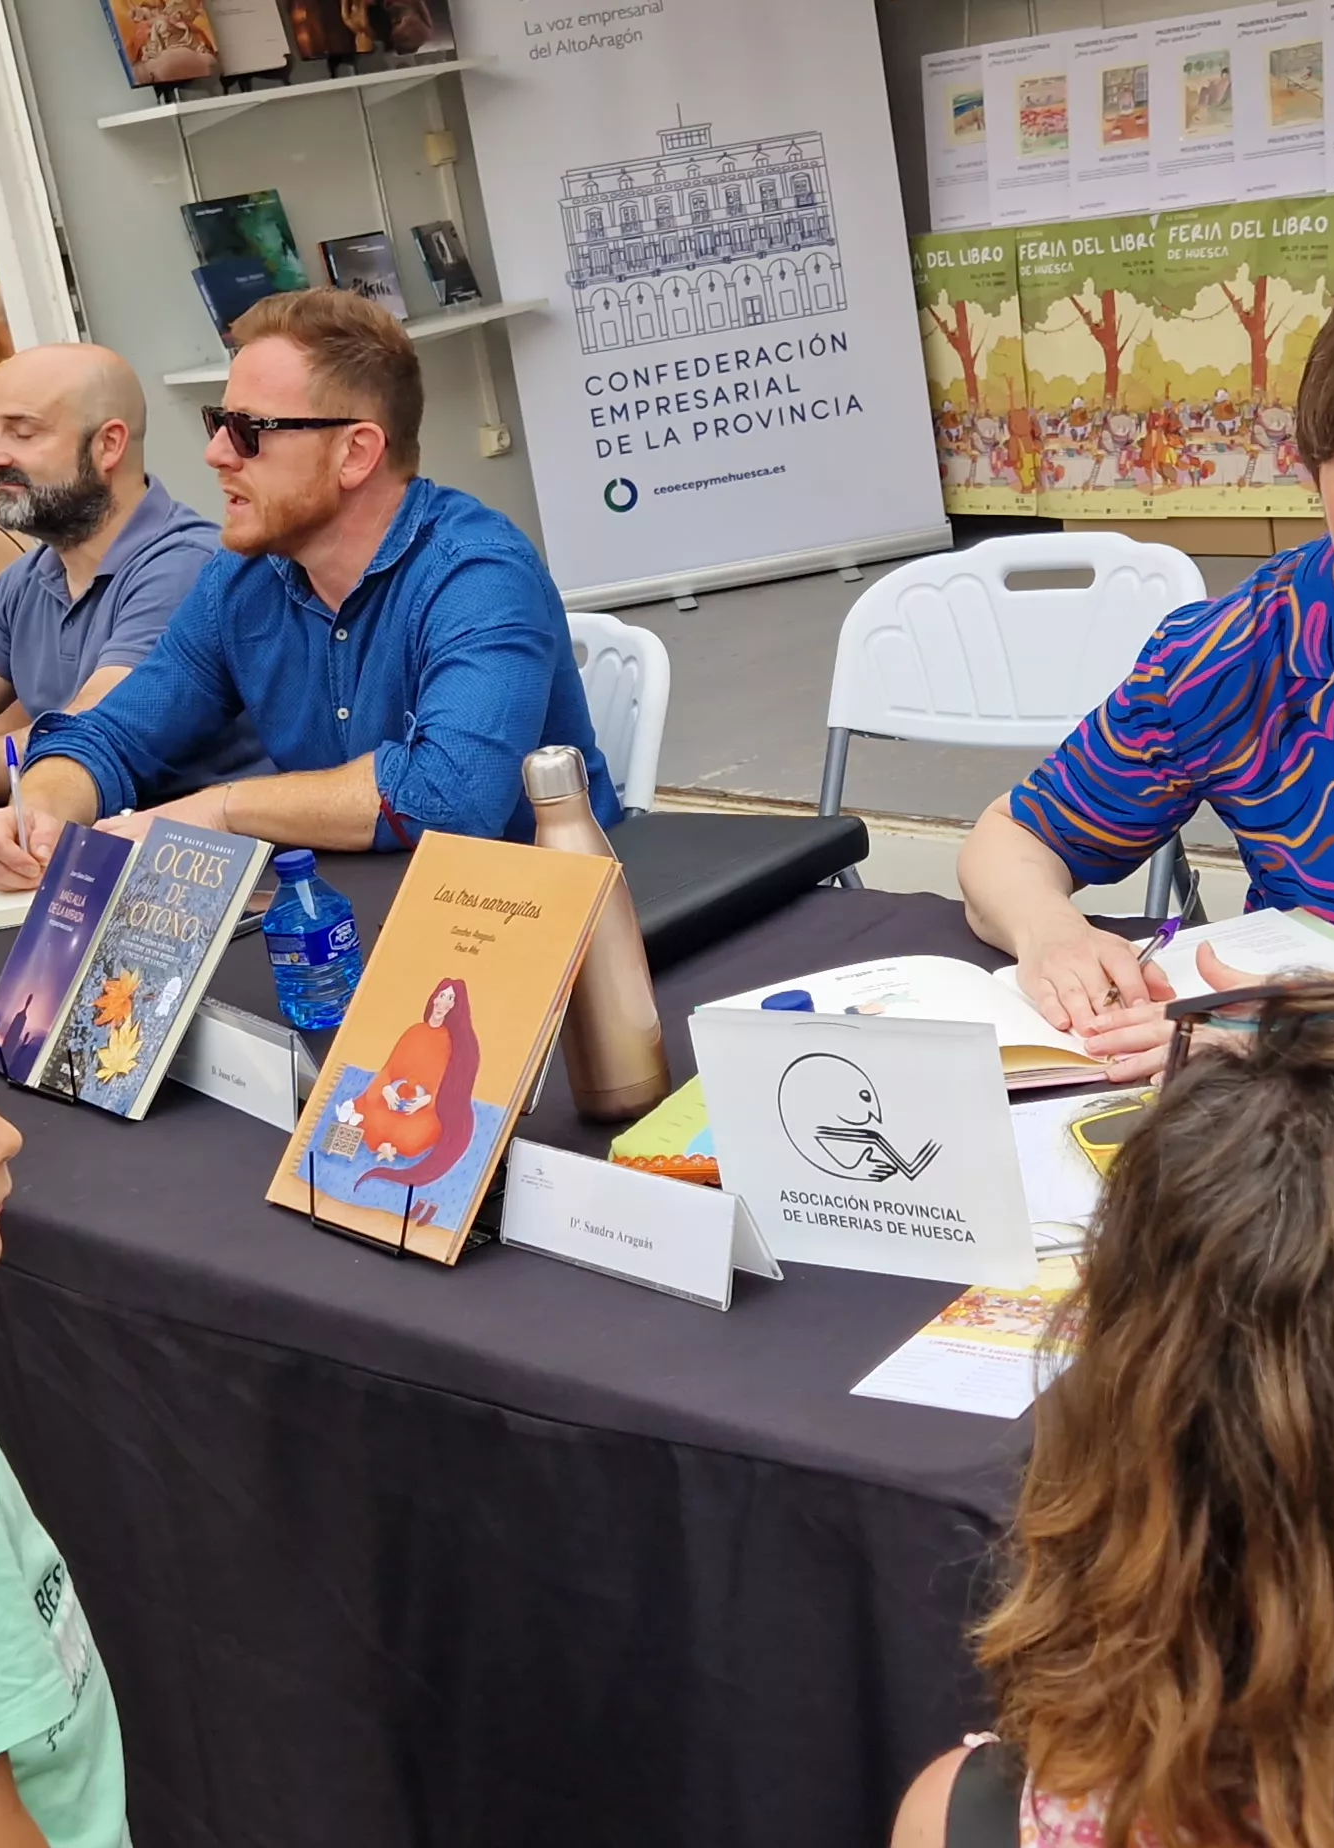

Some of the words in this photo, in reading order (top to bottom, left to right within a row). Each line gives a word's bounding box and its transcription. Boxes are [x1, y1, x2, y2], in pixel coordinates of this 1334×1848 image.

[524, 20, 542, 36] La
[546, 17, 573, 32] voz
[578, 0, 665, 27] empresarial
[529, 42, 552, 60] del
[555, 27, 643, 56] AltoAragón
[1168, 221, 1222, 244] FERIA
[1230, 219, 1265, 240] DEL
[1272, 215, 1328, 237] LIBRO
[927, 251, 954, 268] DEL
[960, 246, 1004, 266] LIBRO
[1019, 240, 1067, 261] FERIA
[1072, 236, 1105, 256] DEL
[1167, 249, 1182, 260] DE
[1185, 246, 1229, 259] HUESCA
[1020, 265, 1032, 277] DE
[1035, 262, 1074, 275] HUESCA
[584, 331, 849, 396] CONFEDERACIÓN
[590, 373, 802, 428] EMPRESARIAL
[595, 434, 634, 459] DE
[645, 427, 681, 450] LA
[692, 394, 865, 441] PROVINCIA
[652, 463, 787, 496] ceoecepymehuesca.es
[165, 832, 182, 842] JUAN
[154, 843, 230, 888] OCRES
[167, 883, 191, 906] DE
[433, 883, 454, 904] Las
[455, 887, 478, 909] tres
[479, 897, 543, 925] naranjitas
[130, 901, 200, 943] OTOÑO
[218, 1067, 231, 1081] Juan
[779, 1189, 869, 1213] ASOCIACIÓN
[874, 1200, 966, 1223] PROVINCIAL
[584, 1221, 614, 1241] Sandra
[617, 1231, 654, 1250] Araguás
[783, 1209, 802, 1223] DE
[806, 1211, 883, 1233] LIBRERIAS
[887, 1221, 908, 1236] DE
[911, 1223, 976, 1244] HUESCA
